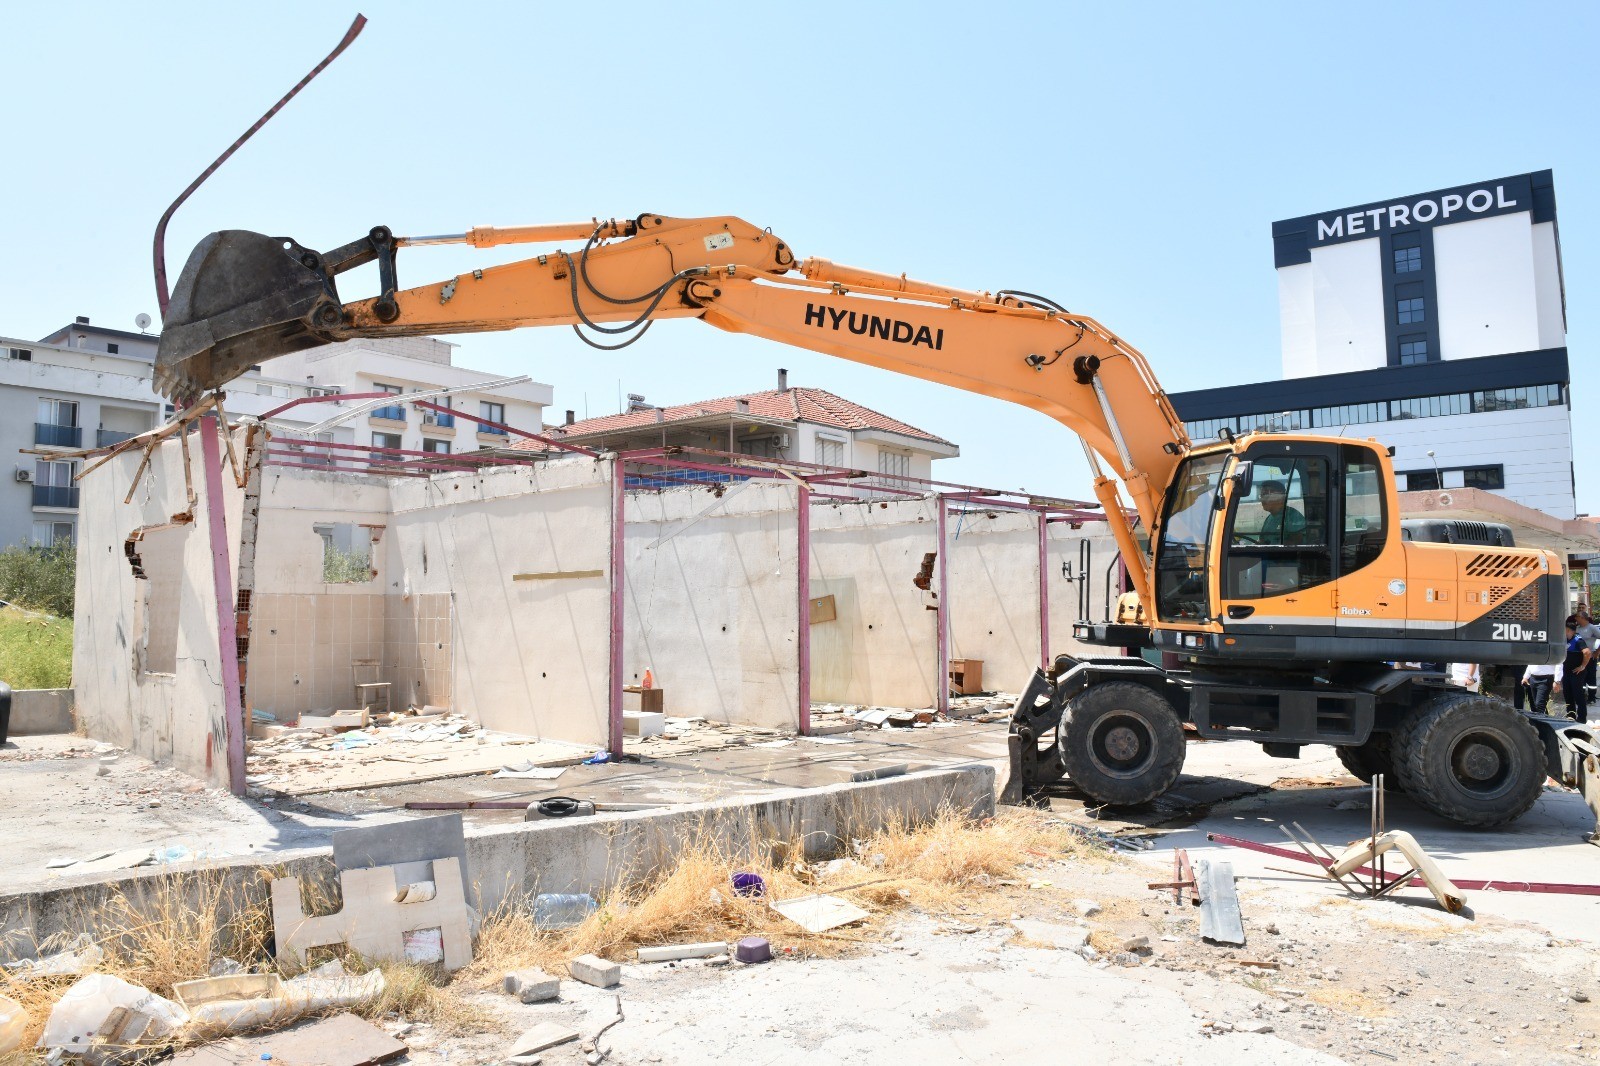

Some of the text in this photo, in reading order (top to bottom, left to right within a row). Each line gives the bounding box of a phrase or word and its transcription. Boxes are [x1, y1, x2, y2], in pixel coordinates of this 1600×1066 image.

[1317, 185, 1517, 240] METROPOL
[804, 303, 944, 350] HYUNDAI
[1341, 606, 1371, 615] Robex
